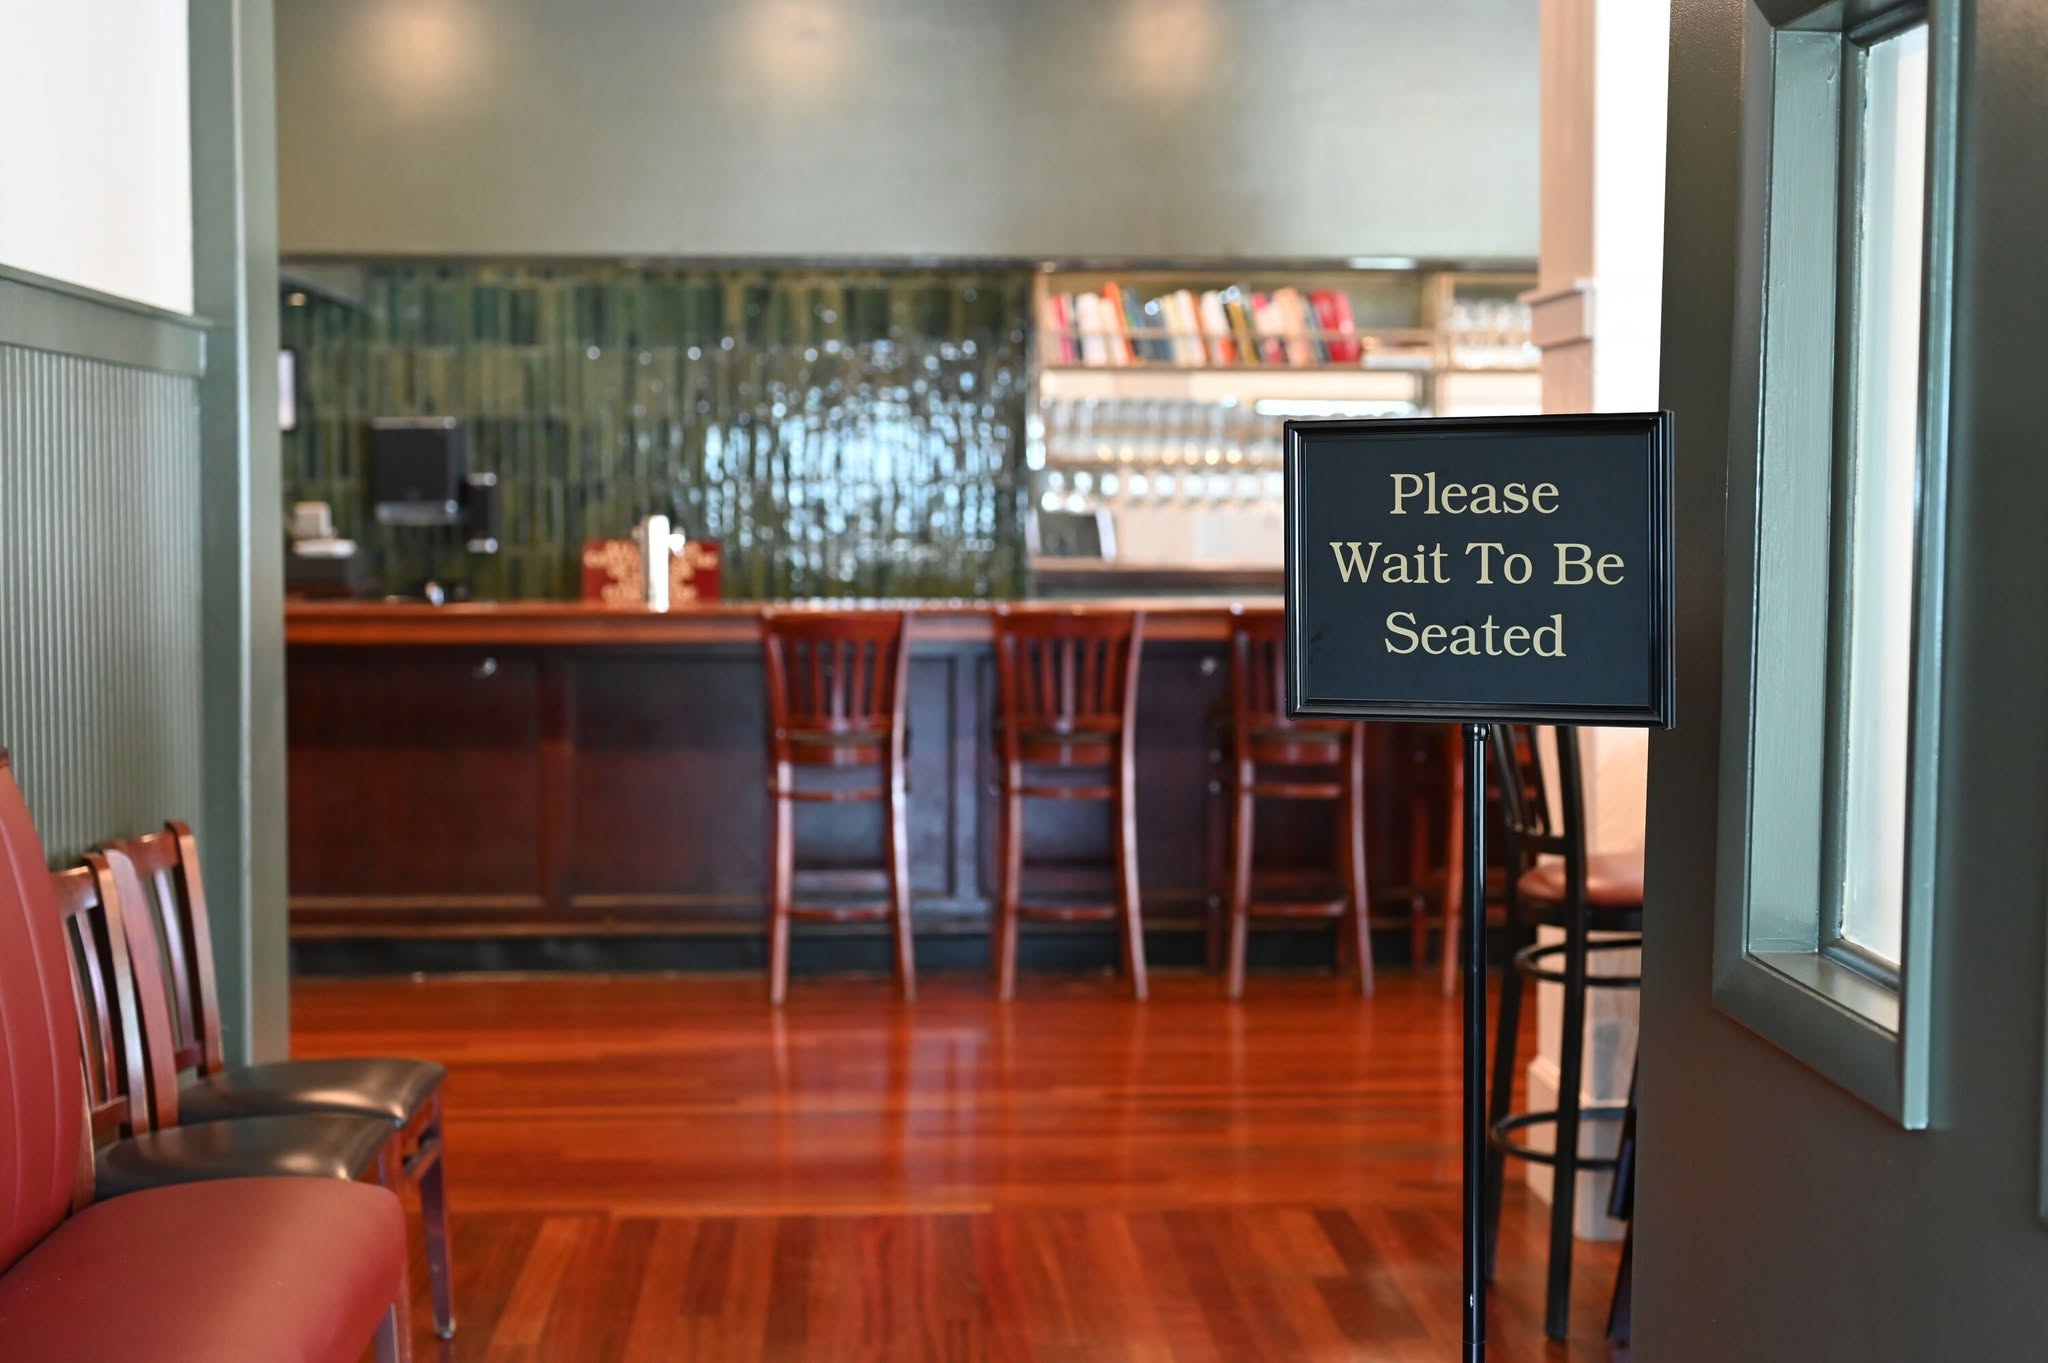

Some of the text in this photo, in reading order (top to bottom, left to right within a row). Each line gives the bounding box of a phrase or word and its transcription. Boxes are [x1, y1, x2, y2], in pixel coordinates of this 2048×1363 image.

[1390, 472, 1560, 515] Please
[1329, 542, 1625, 586] Wait To Be
[1384, 612, 1567, 657] Seated
